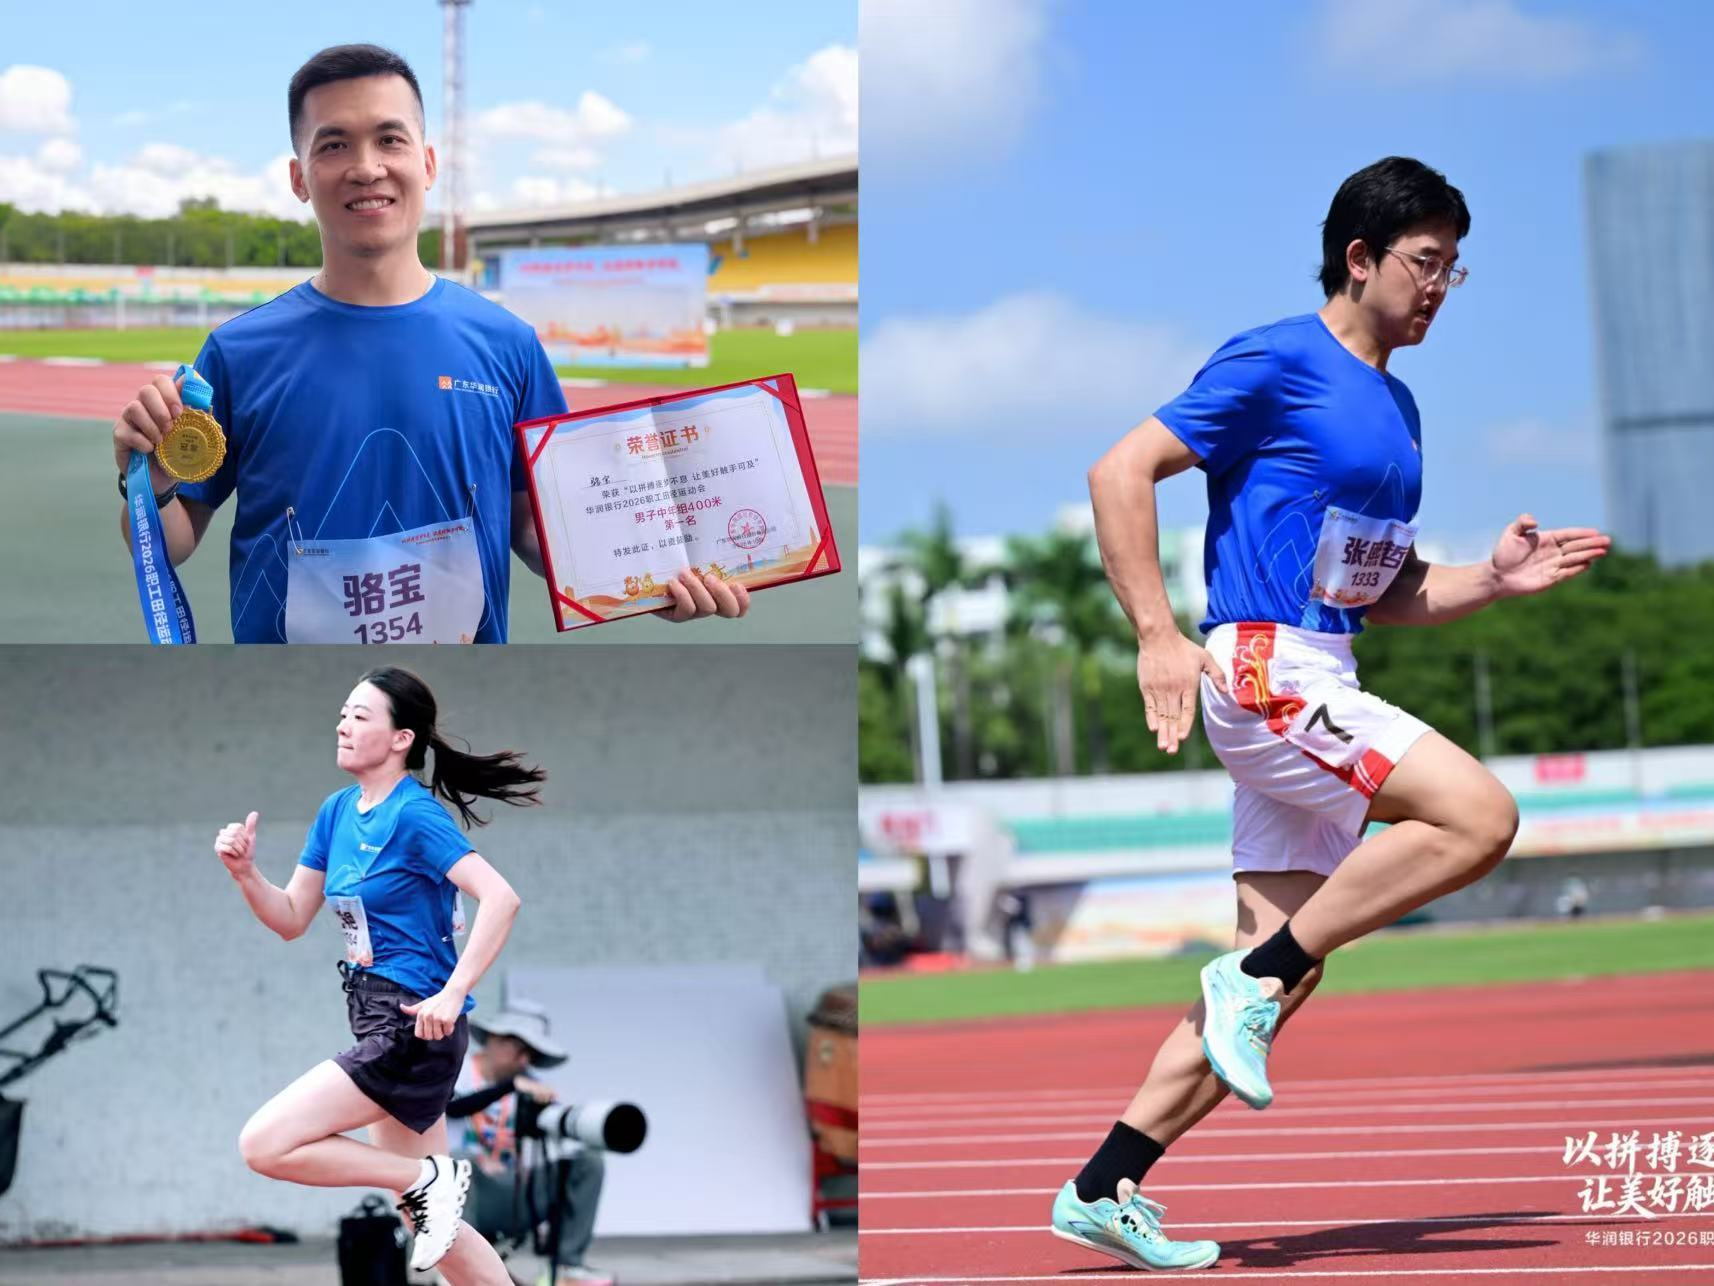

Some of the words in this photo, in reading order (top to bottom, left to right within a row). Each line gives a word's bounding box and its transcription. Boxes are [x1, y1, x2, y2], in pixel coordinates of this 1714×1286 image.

[626, 425, 699, 455] 荣誉证书
[635, 496, 722, 524] 男子中年组400米
[664, 515, 698, 531] 第一名
[343, 563, 425, 616] 骆宝
[1351, 571, 1380, 587] 1333
[353, 611, 423, 644] 1354
